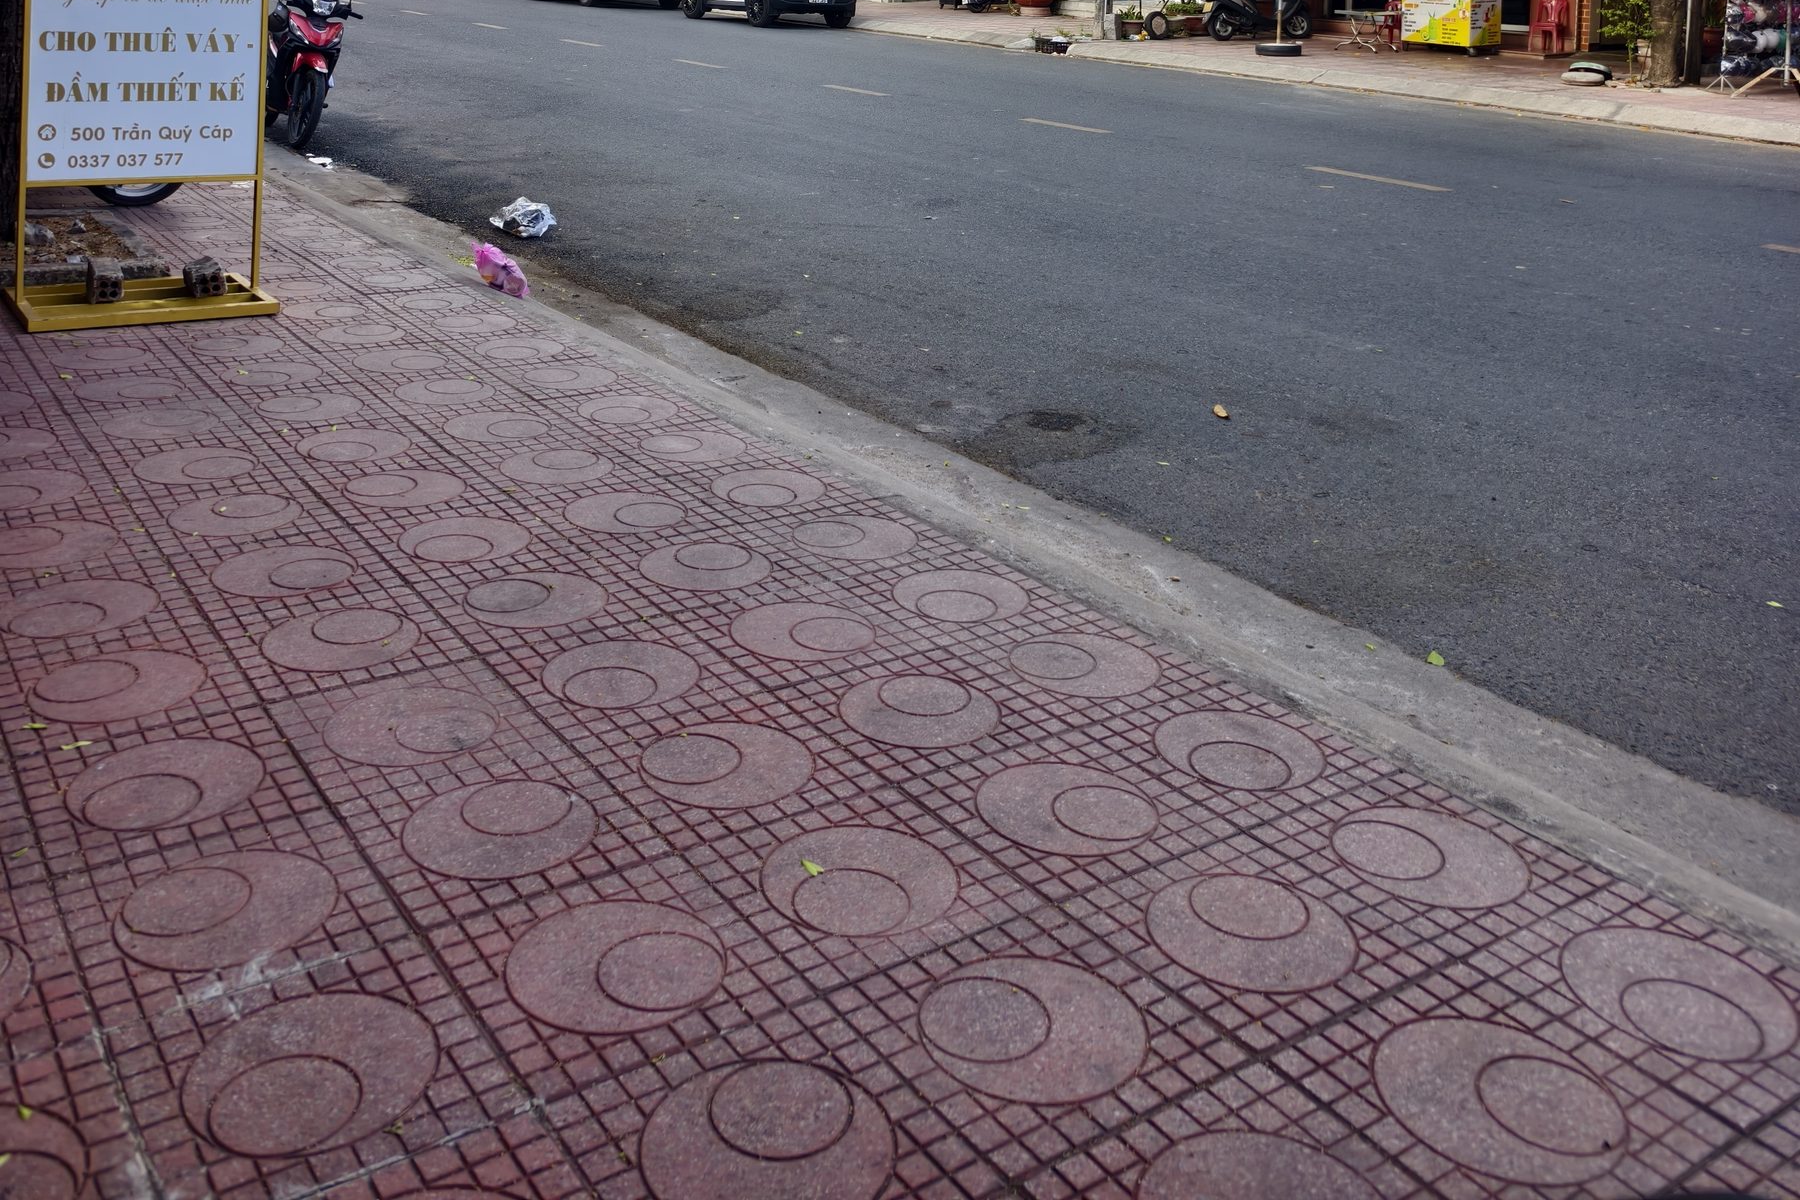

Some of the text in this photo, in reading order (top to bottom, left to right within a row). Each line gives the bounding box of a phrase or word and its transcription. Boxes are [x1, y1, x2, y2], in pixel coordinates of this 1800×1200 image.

[38, 30, 97, 52] CHO
[104, 27, 177, 52] THUÊ
[184, 28, 241, 52] VÁY
[46, 71, 246, 103] ĐẦM THIẾT KẾ
[70, 123, 233, 143] 500 Trần Quý Cáp
[67, 152, 184, 168] 0337 037 577
